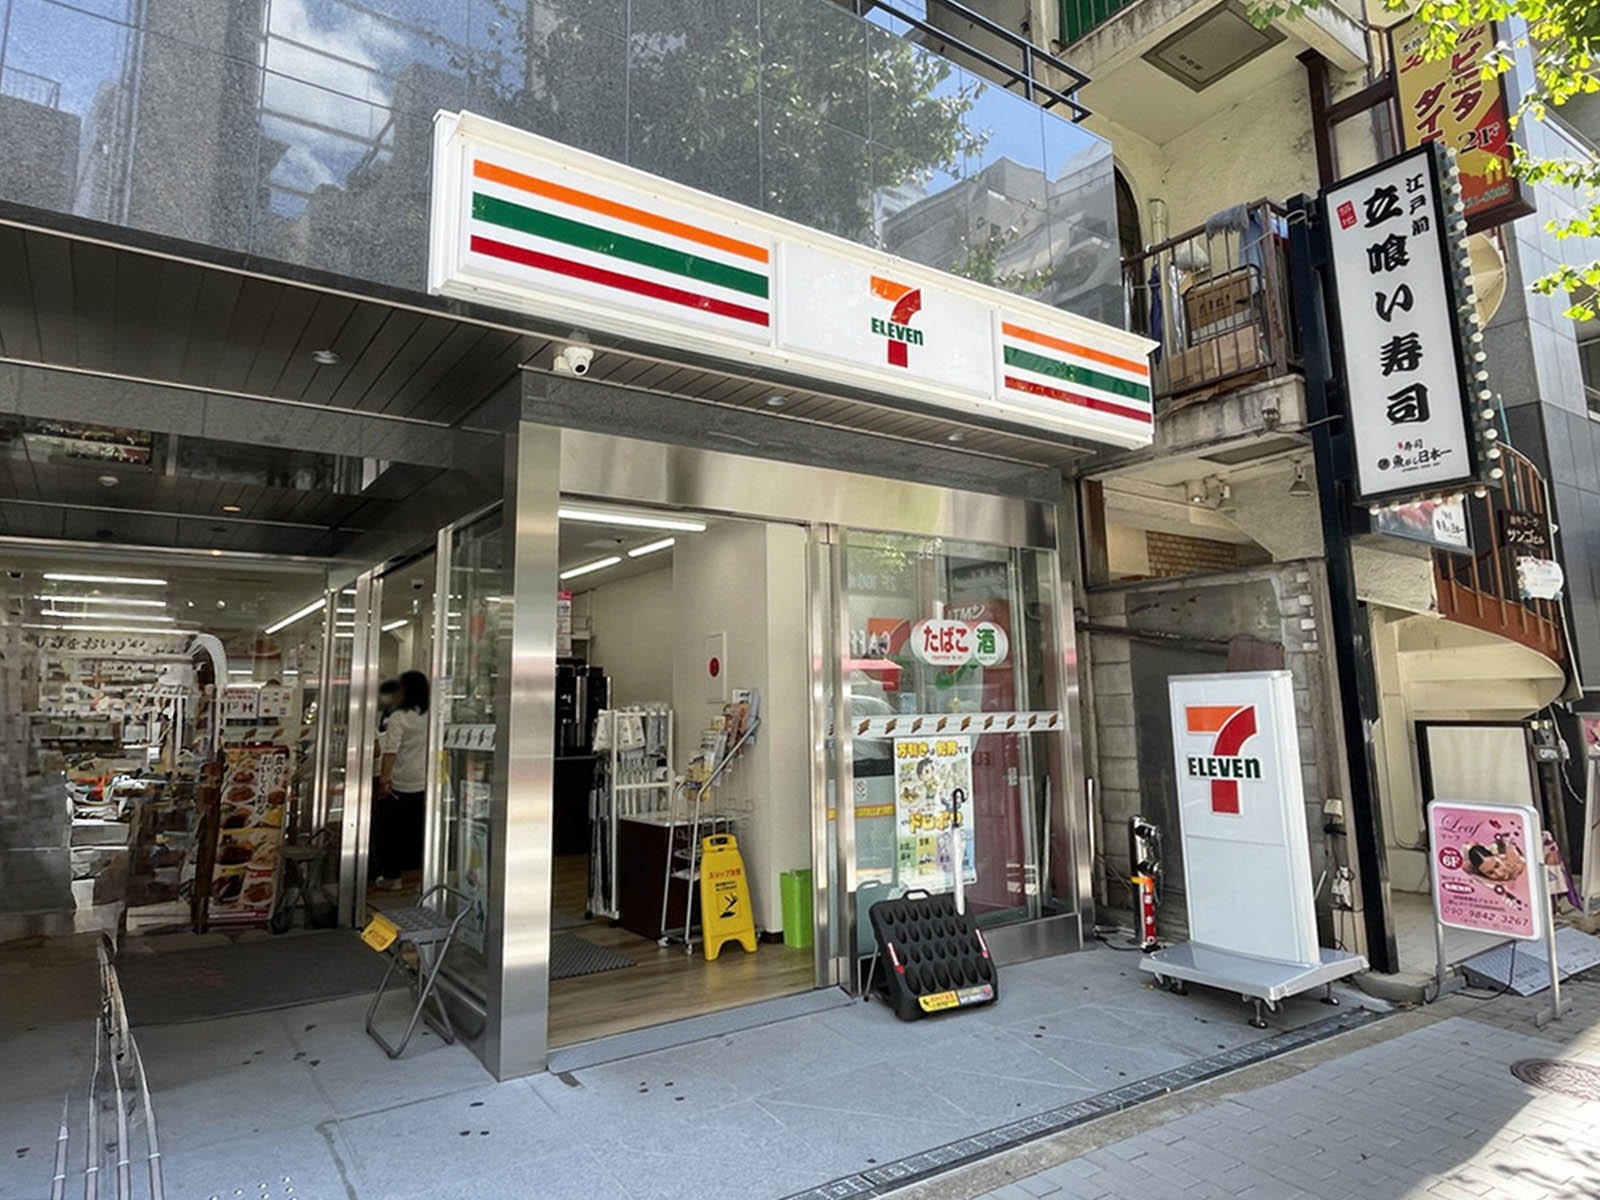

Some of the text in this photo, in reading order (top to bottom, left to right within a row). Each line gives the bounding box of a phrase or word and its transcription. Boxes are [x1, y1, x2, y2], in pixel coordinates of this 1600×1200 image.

[1457, 122, 1500, 154] 2F
[870, 274, 921, 368] 7
[1363, 185, 1430, 426] 立喰い寿司
[923, 626, 969, 653] たばこ
[976, 628, 995, 654] 酒
[1186, 705, 1257, 814] 7
